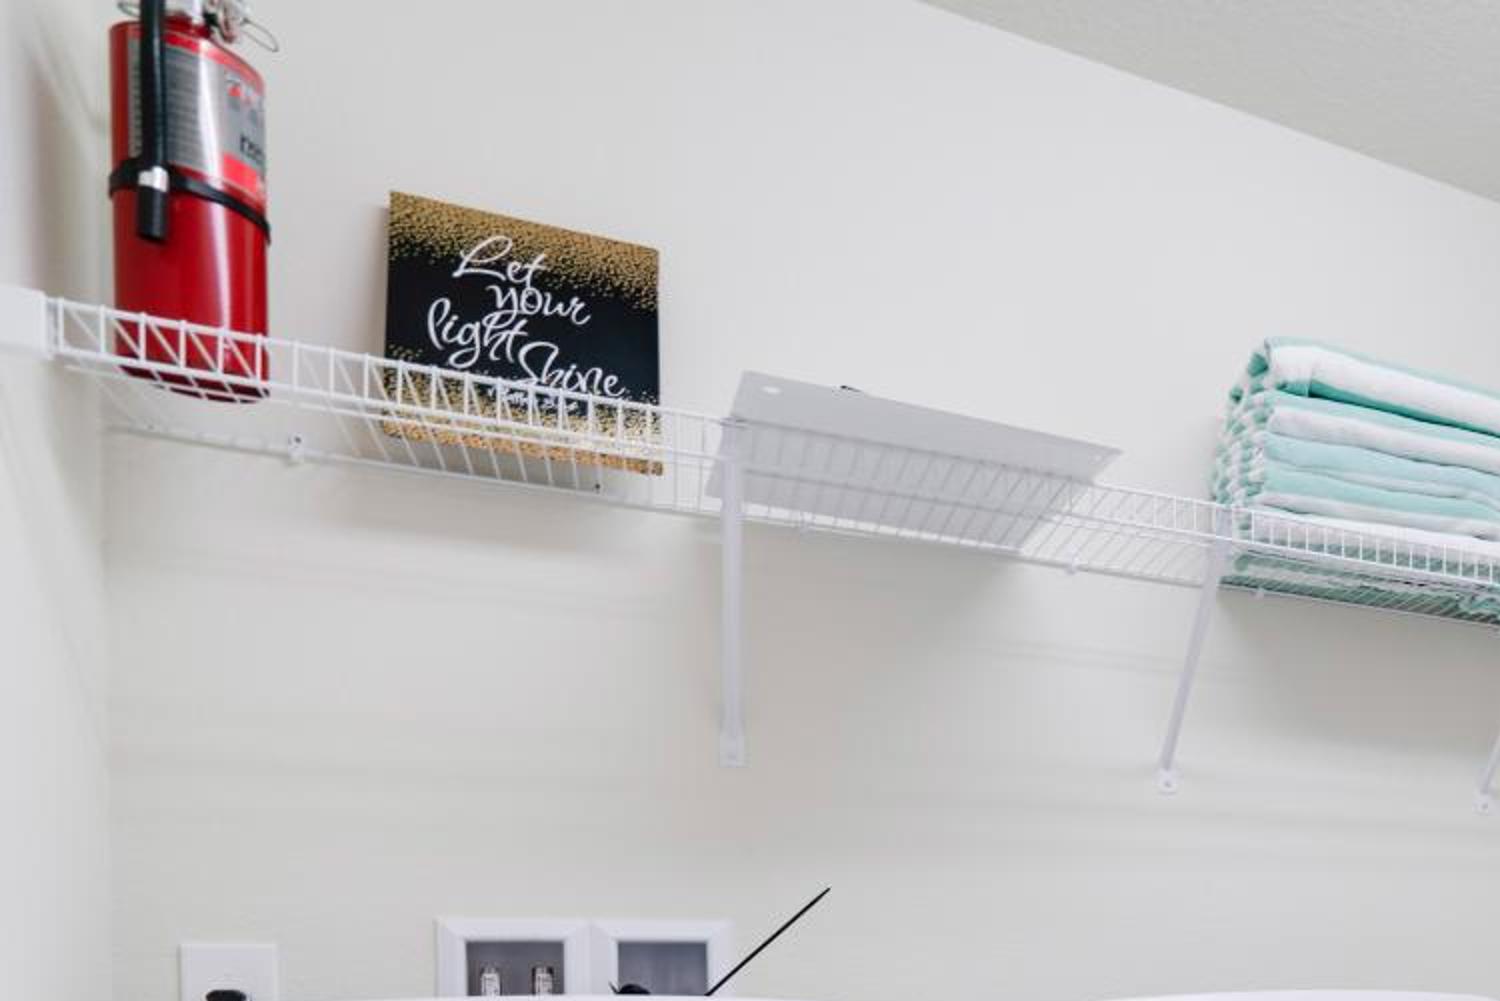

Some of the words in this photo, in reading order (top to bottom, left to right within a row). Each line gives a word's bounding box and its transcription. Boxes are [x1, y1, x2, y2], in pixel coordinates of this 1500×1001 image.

[452, 235, 546, 290] Let
[485, 283, 591, 325] your
[427, 297, 528, 368] light
